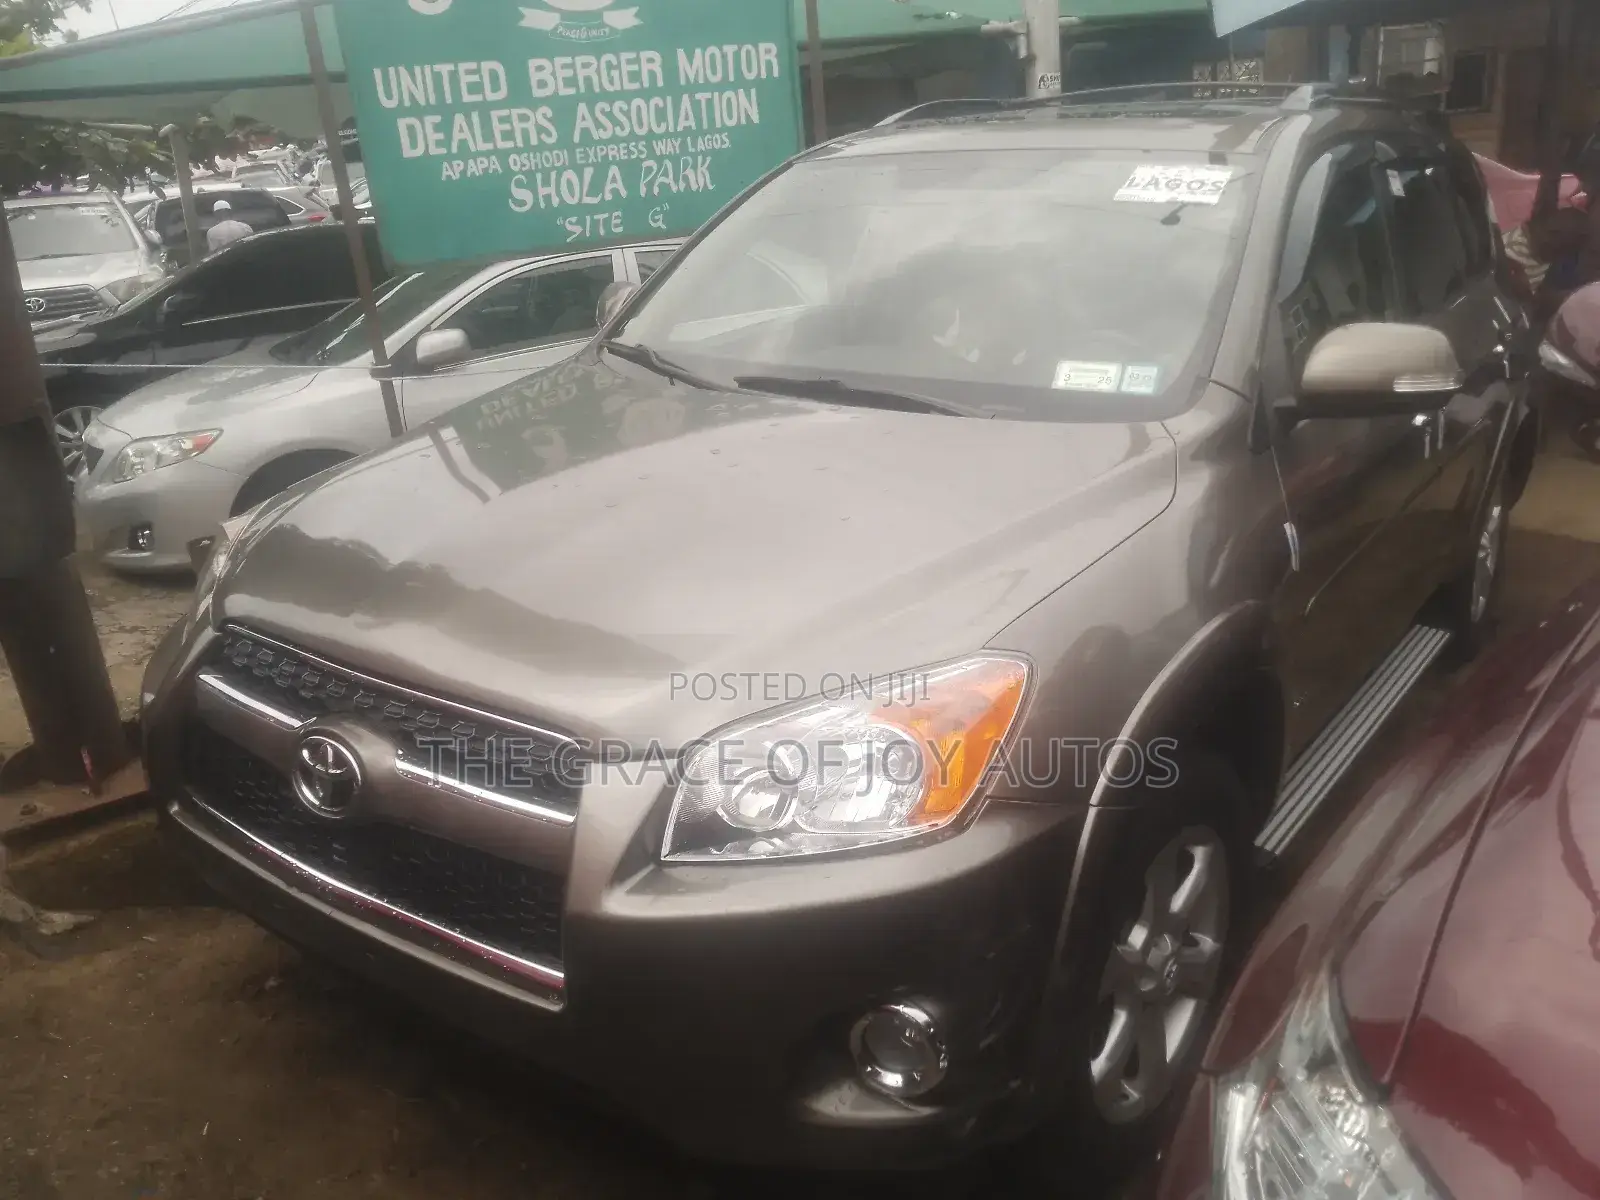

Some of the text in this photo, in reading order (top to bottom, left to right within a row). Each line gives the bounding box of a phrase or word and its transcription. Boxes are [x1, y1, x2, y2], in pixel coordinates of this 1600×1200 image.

[373, 42, 780, 109] UNITED BERGER MOTOR
[397, 88, 760, 159] DEALERS ASSOCIATION
[441, 156, 503, 182] APAPA
[508, 150, 569, 173] OSHODI
[576, 140, 647, 165] EXPRESS
[652, 137, 681, 156] WAY
[508, 155, 716, 213] SHOLA PARK
[1122, 175, 1225, 192] LAGOS
